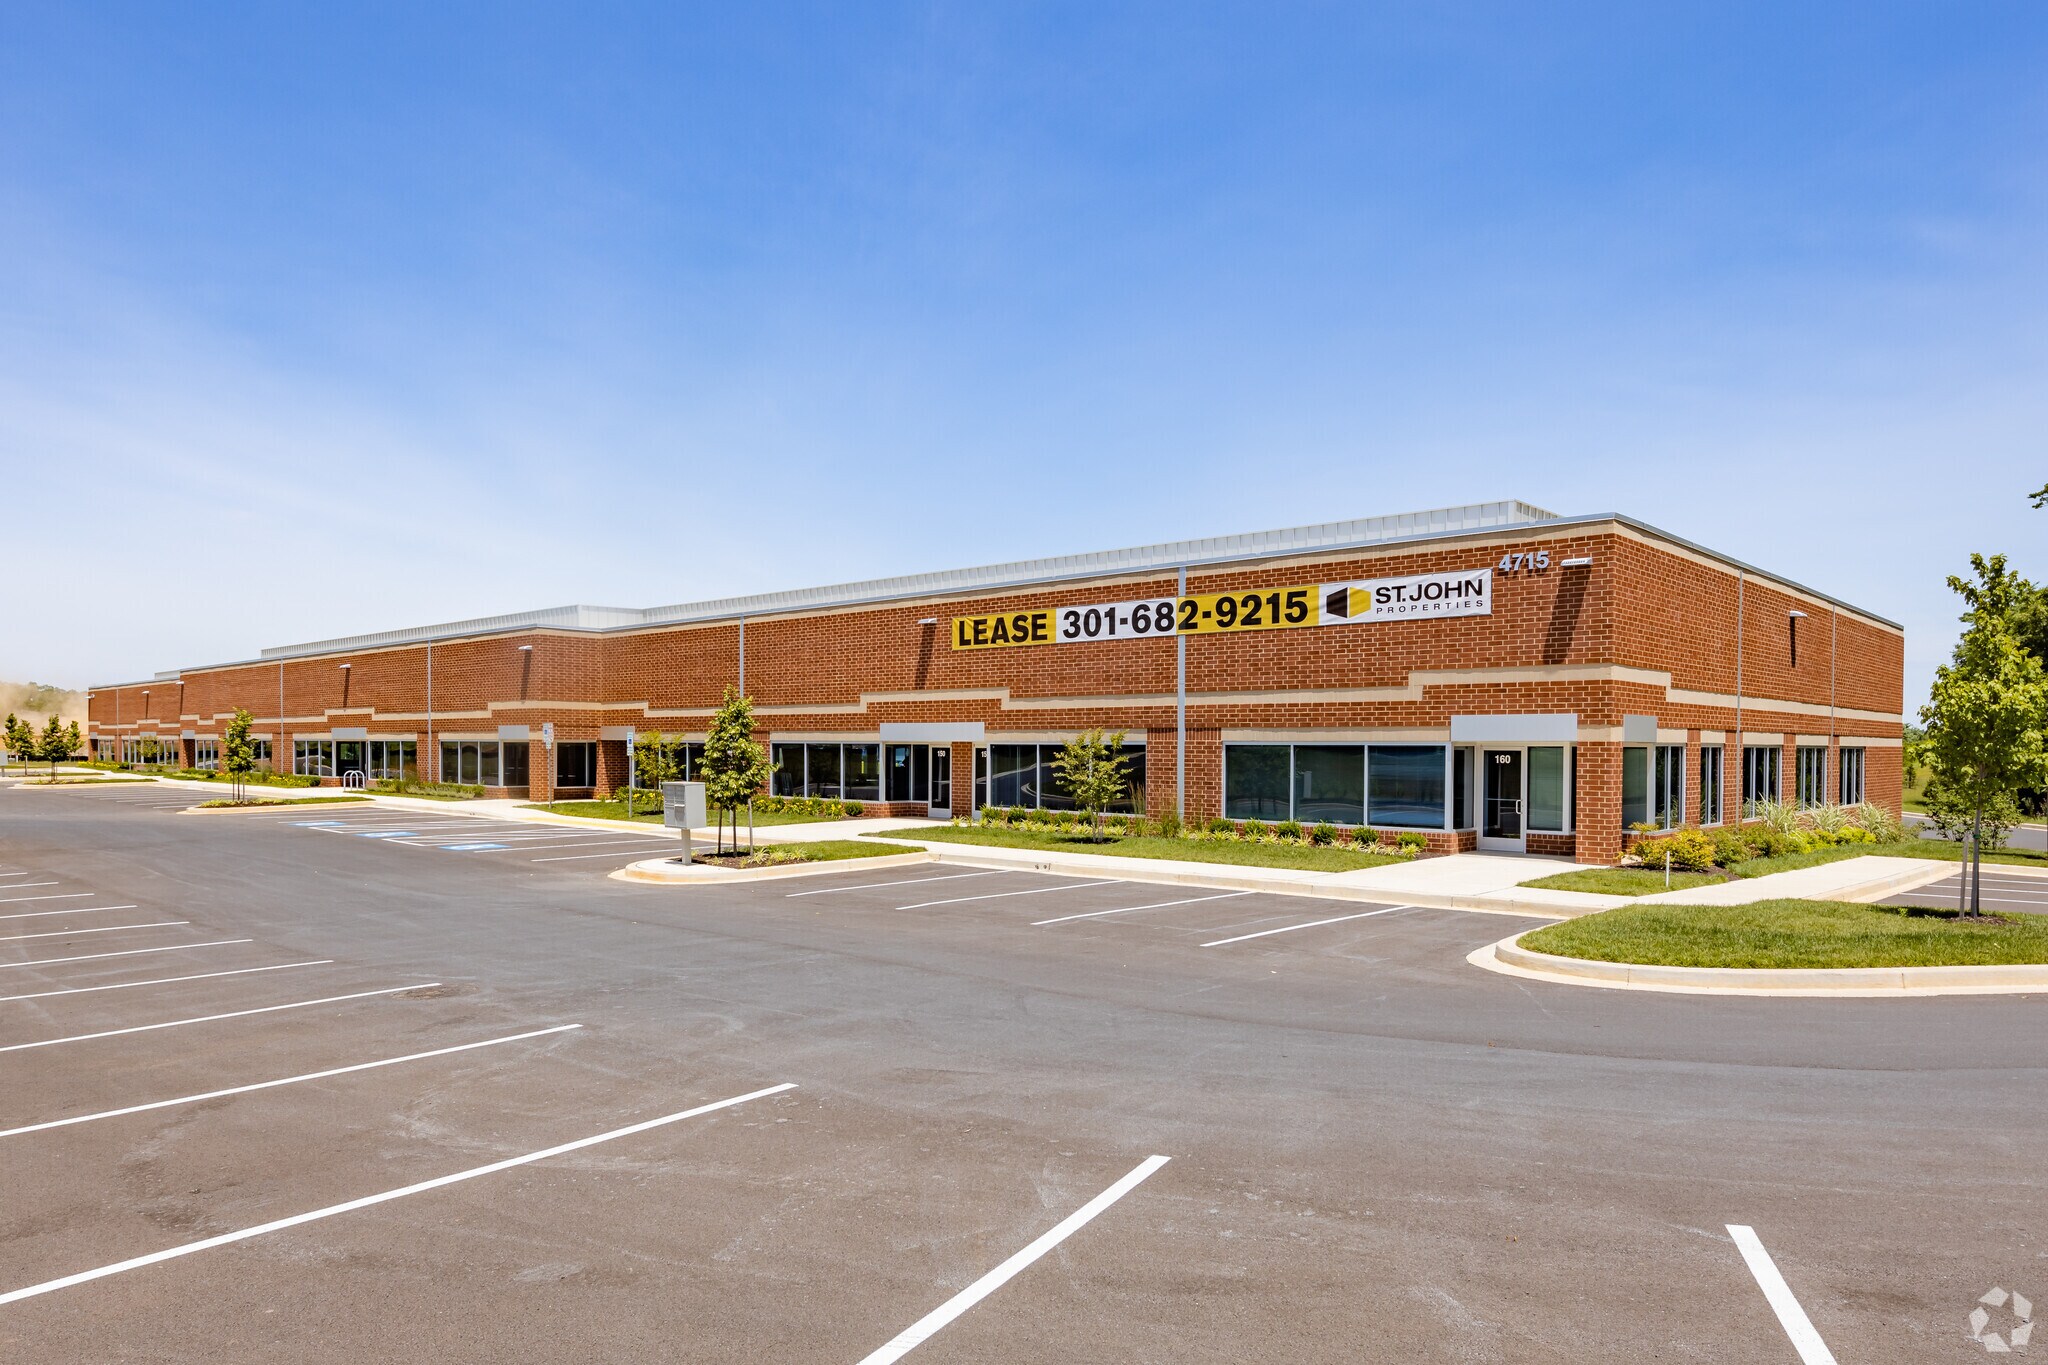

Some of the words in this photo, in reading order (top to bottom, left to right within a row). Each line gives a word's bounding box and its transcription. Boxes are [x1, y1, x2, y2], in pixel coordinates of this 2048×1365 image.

[1499, 551, 1549, 571] 4715
[1376, 600, 1483, 614] PROPERTIES
[959, 613, 1047, 646] LEASE
[1062, 590, 1308, 639] 301-682-9215
[1494, 754, 1511, 764] 160
